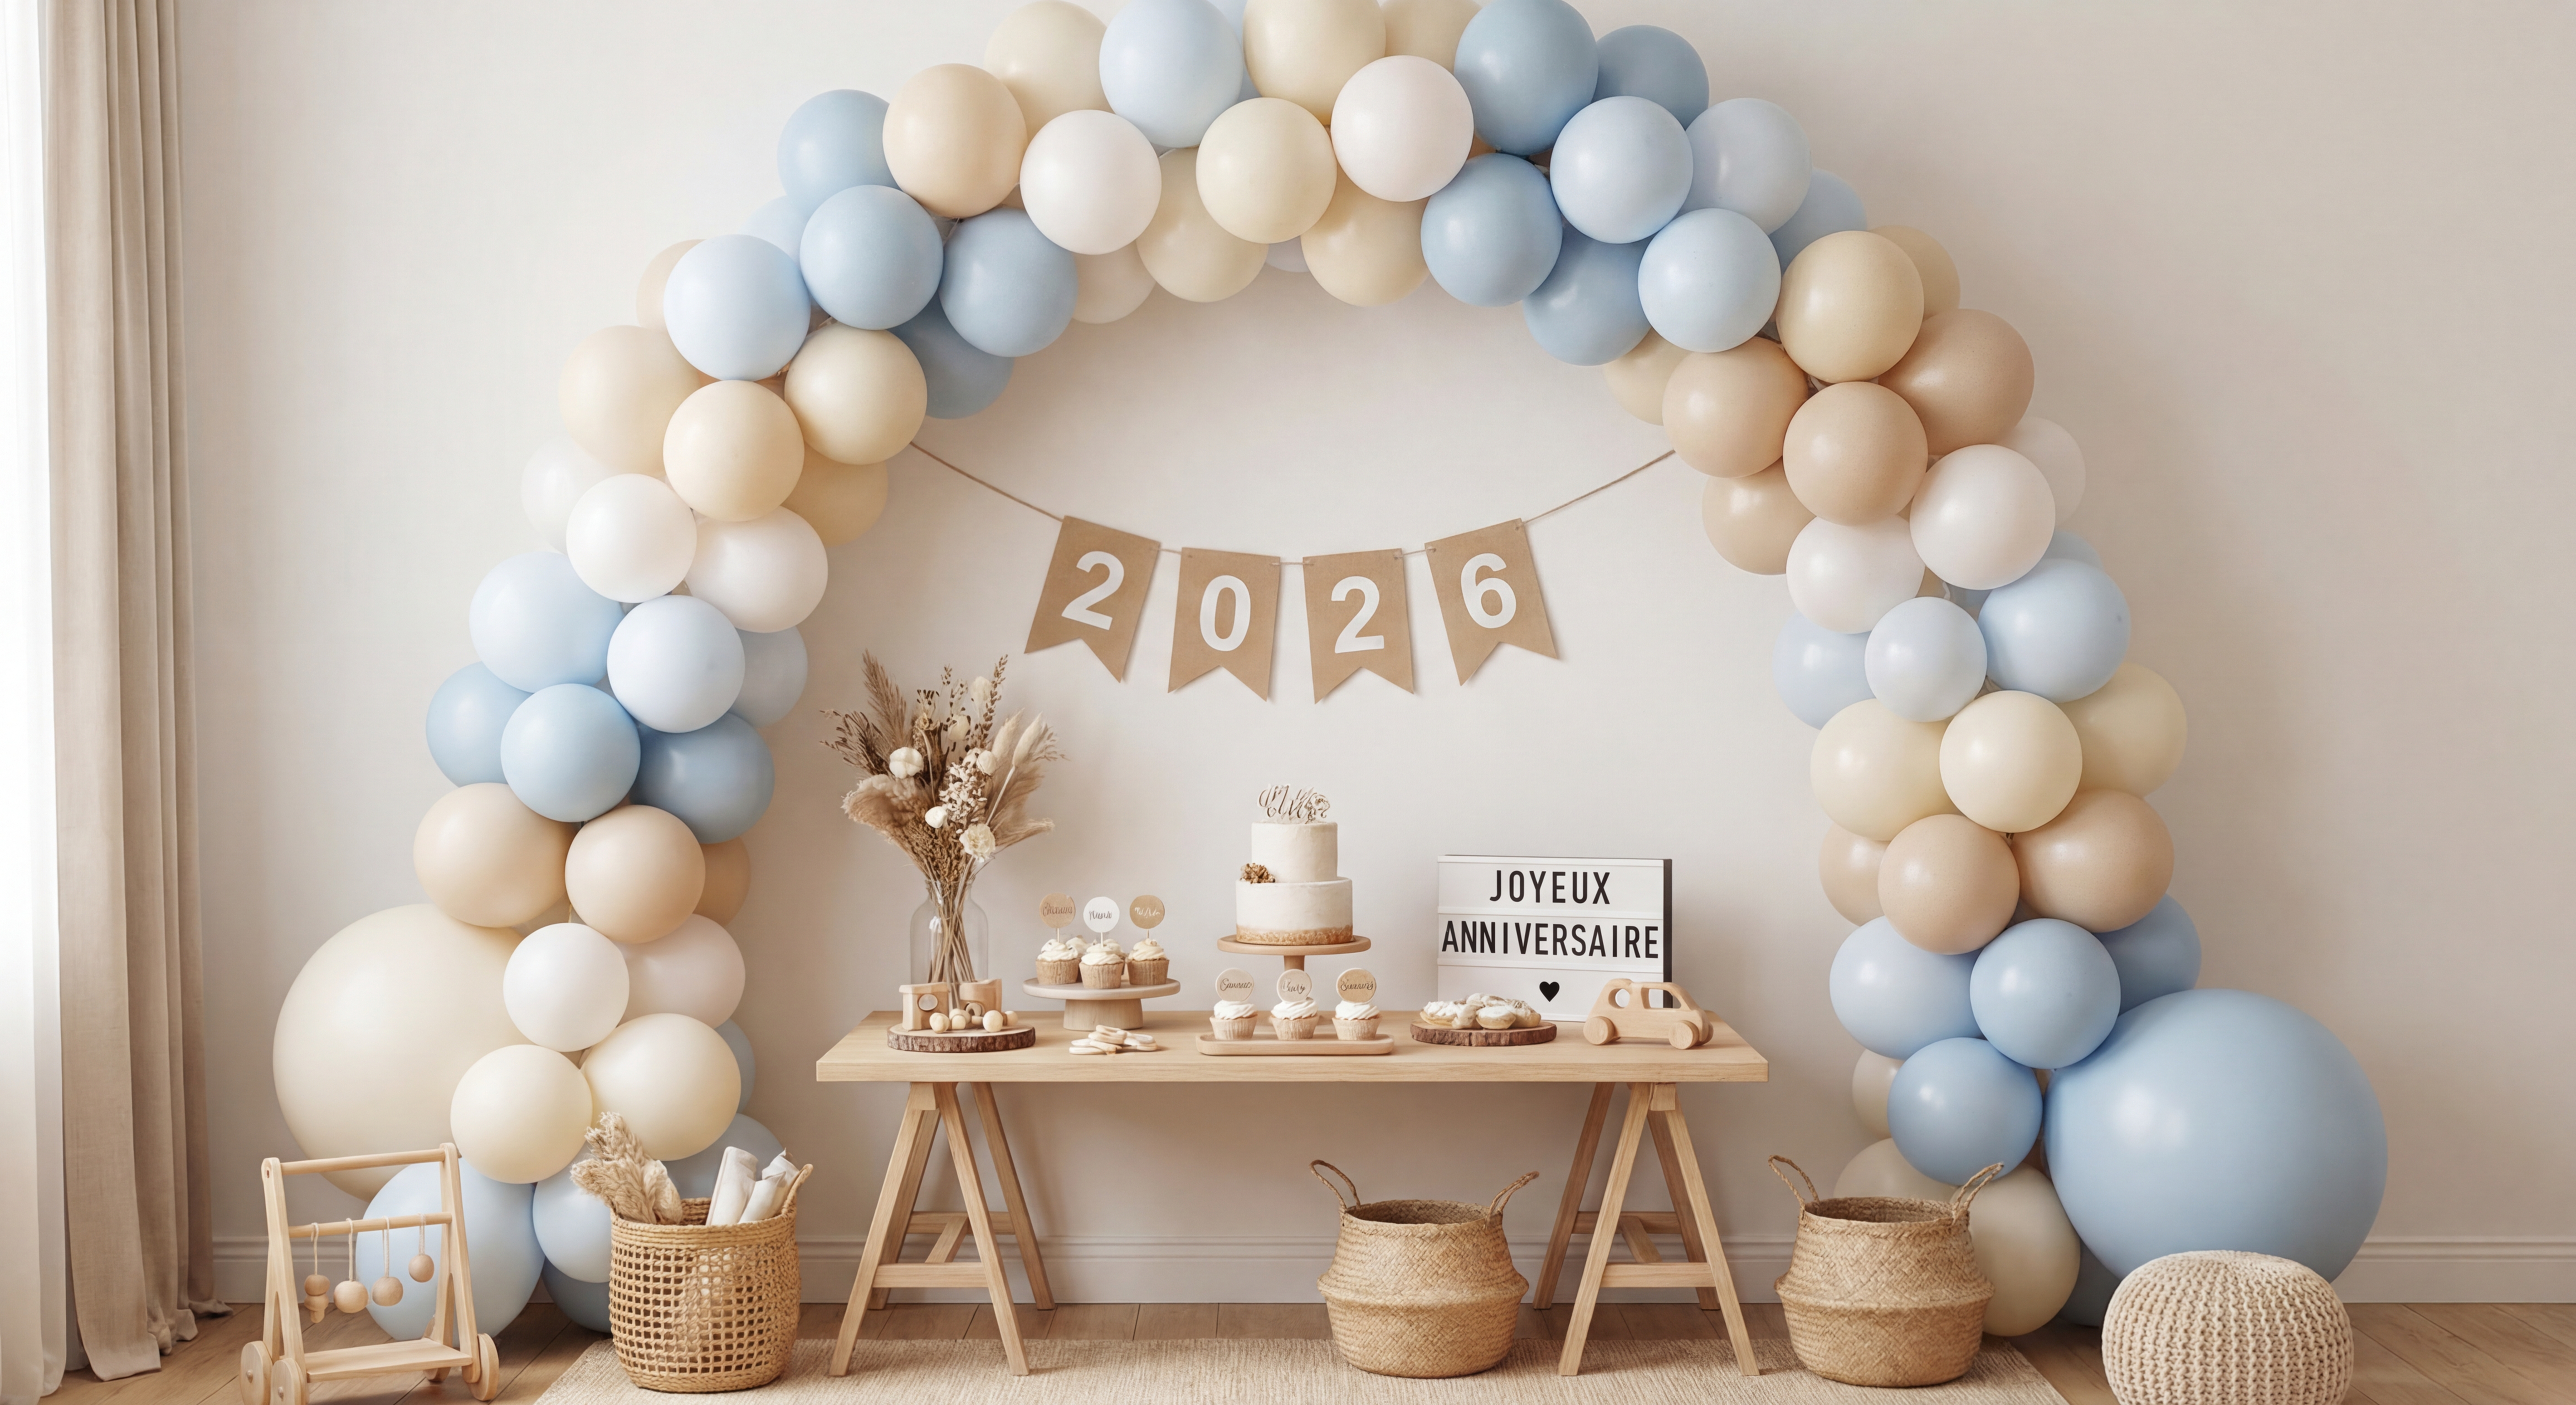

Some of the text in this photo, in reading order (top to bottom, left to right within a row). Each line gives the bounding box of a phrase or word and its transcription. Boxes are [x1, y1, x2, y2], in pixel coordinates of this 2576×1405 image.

[1061, 551, 1517, 654] 2026
[1490, 870, 1610, 905] JOYEUX
[1442, 920, 1658, 959] ANNIVERSAIRE
